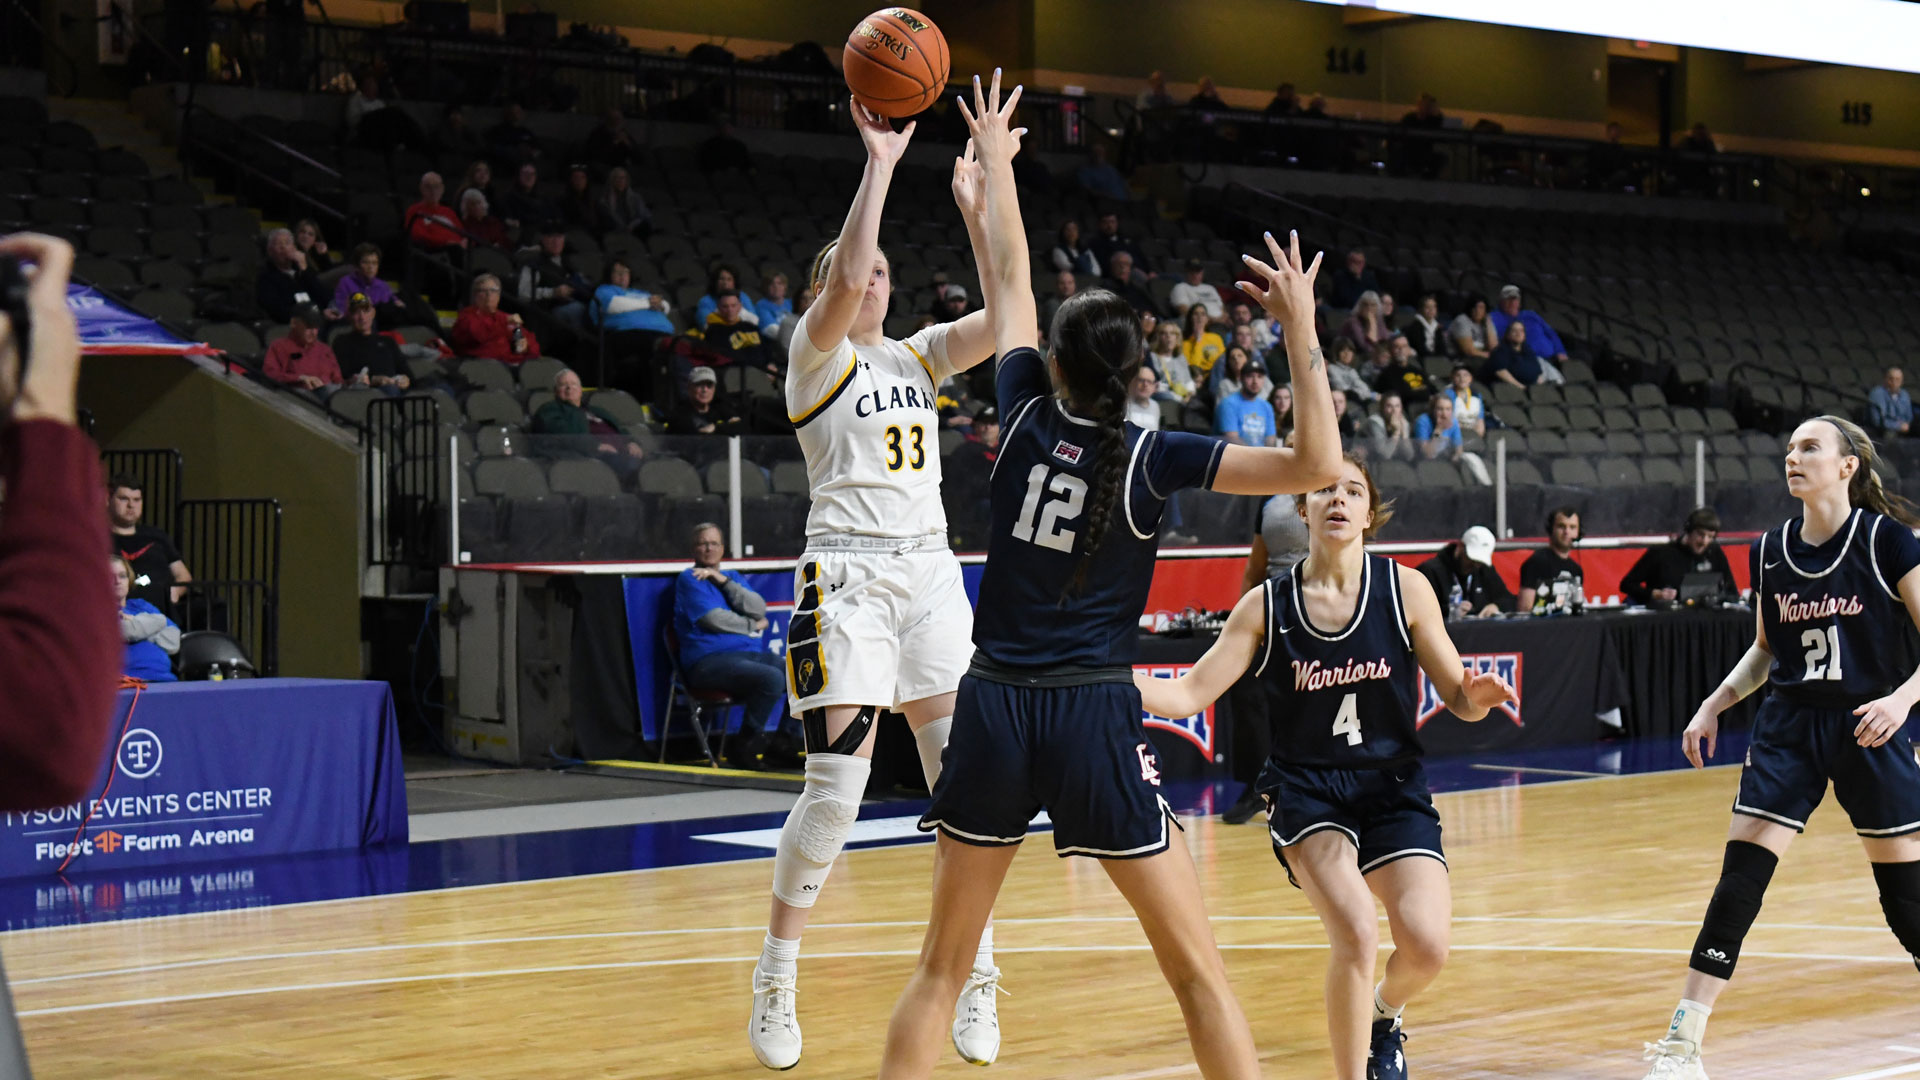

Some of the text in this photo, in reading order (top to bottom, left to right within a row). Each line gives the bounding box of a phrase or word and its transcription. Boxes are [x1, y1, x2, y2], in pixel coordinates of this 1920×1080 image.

[1326, 46, 1367, 74] 114
[1842, 101, 1873, 125] 115
[855, 385, 938, 418] CLARK
[884, 423, 925, 472] 33
[1011, 463, 1089, 554] 12
[1773, 592, 1864, 624] Warriors
[1801, 624, 1843, 681] 21
[1291, 657, 1392, 692] Warriors
[1332, 692, 1363, 747] 4
[89, 793, 180, 820] EVENTS
[185, 787, 272, 813] CENTER
[35, 838, 94, 861] Fleet
[124, 833, 181, 852] Farm
[189, 827, 254, 847] Arena
